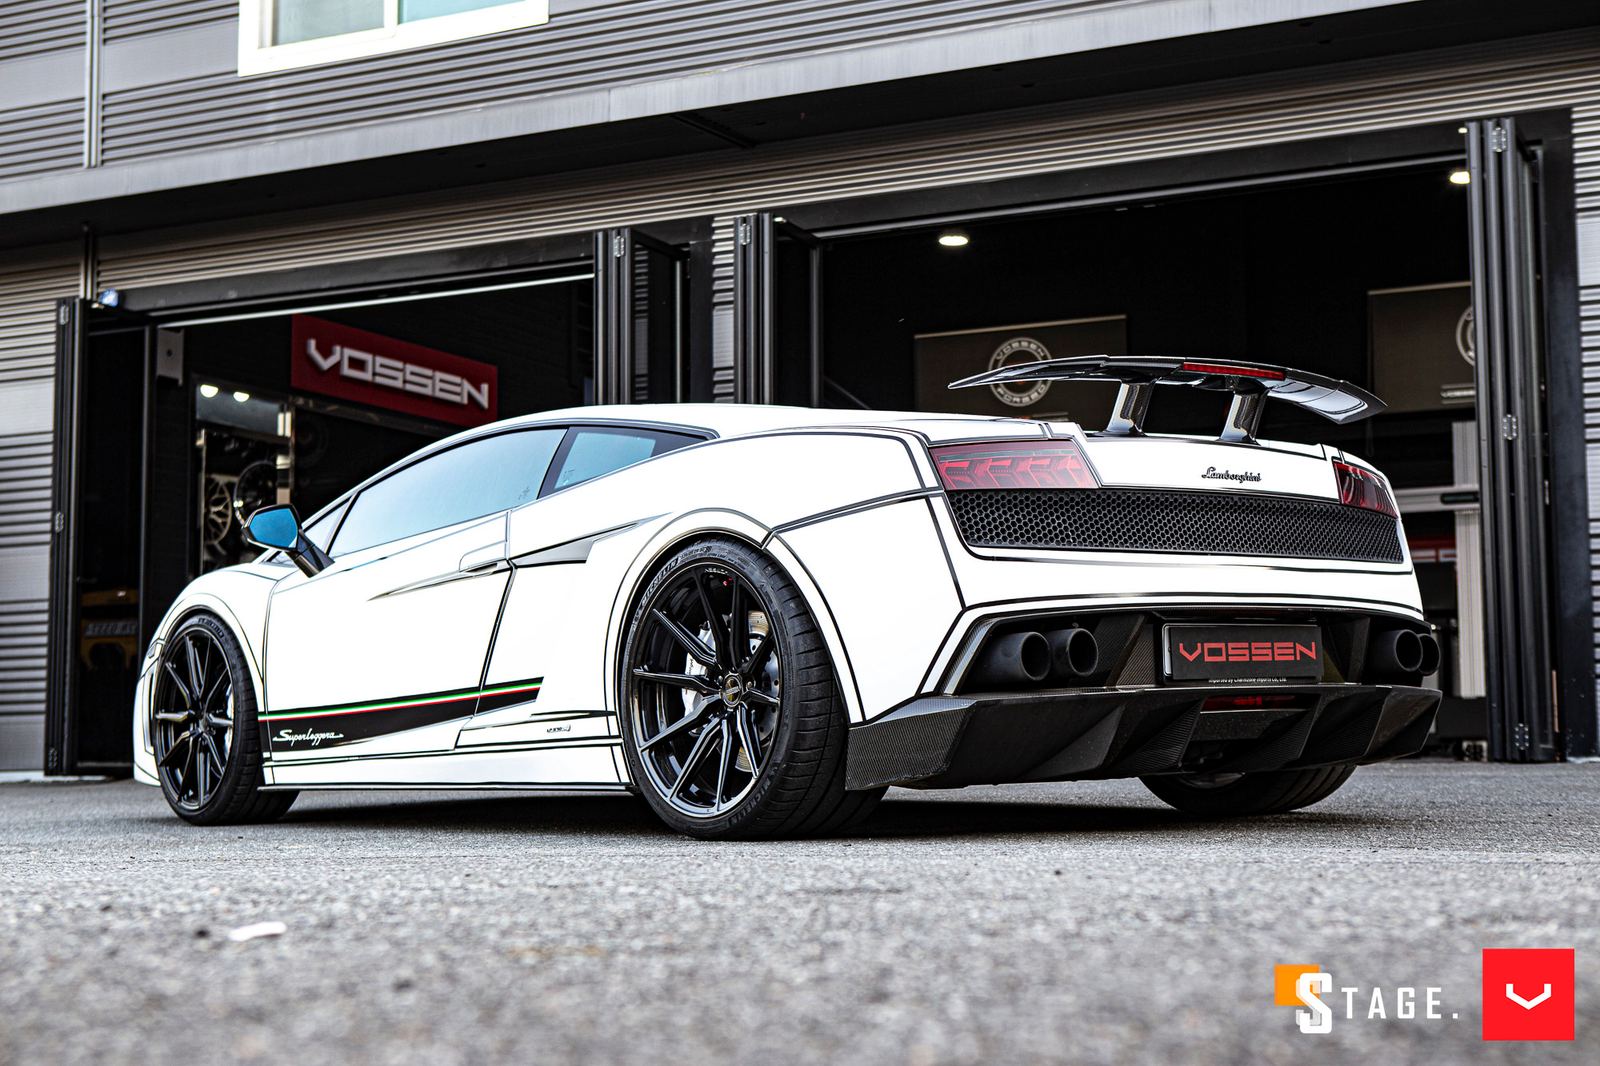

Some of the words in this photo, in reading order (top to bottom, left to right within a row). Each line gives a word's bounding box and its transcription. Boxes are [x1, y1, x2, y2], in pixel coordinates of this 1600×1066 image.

[995, 341, 1046, 361] VOSSEN
[307, 338, 489, 410] VOSSEN
[1201, 466, 1262, 484] Lamborghini
[1179, 641, 1316, 662] VOSSEN
[272, 728, 345, 747] Superleggera
